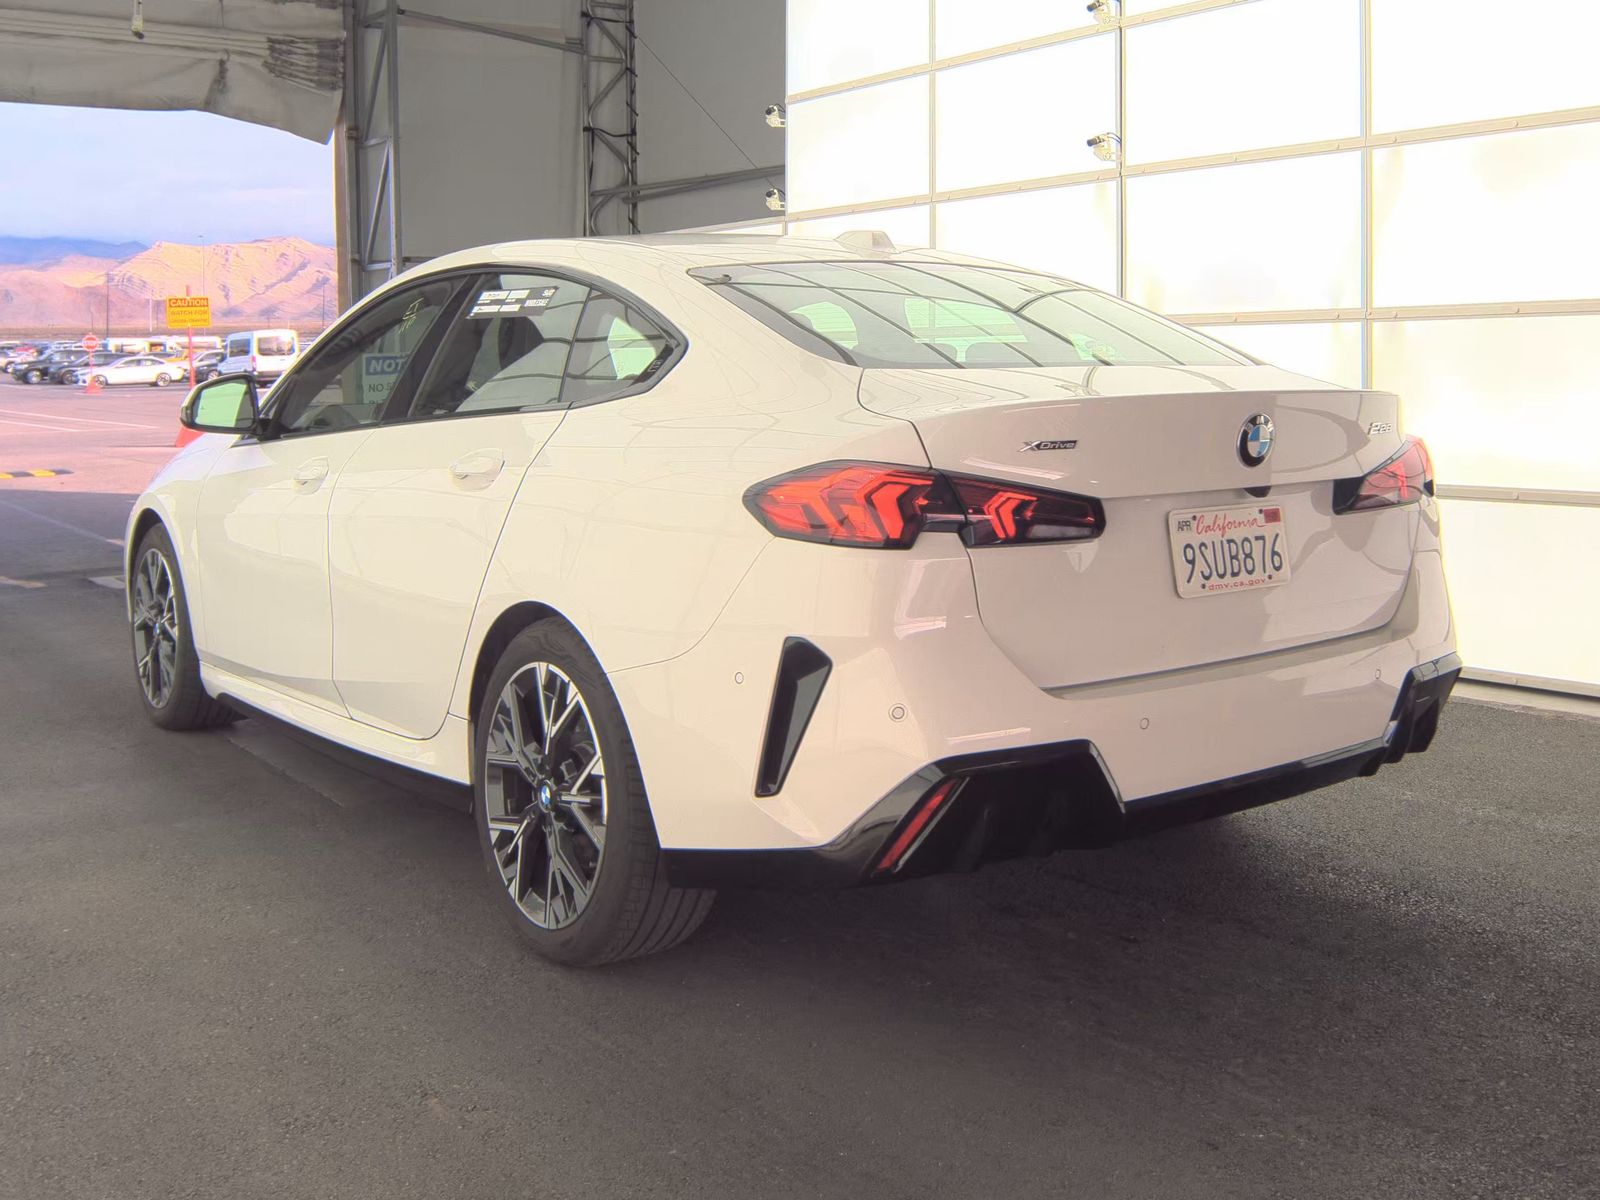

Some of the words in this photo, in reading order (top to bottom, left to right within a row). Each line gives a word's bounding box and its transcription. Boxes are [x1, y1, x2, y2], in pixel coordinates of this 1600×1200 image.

[170, 298, 208, 307] CAUTION
[369, 359, 407, 372] NOT
[368, 383, 384, 392] NO
[1177, 520, 1192, 532] APR
[1196, 513, 1266, 539] California
[1183, 533, 1283, 584] 9SUB876
[1208, 578, 1267, 591] dmv.ca.gov
